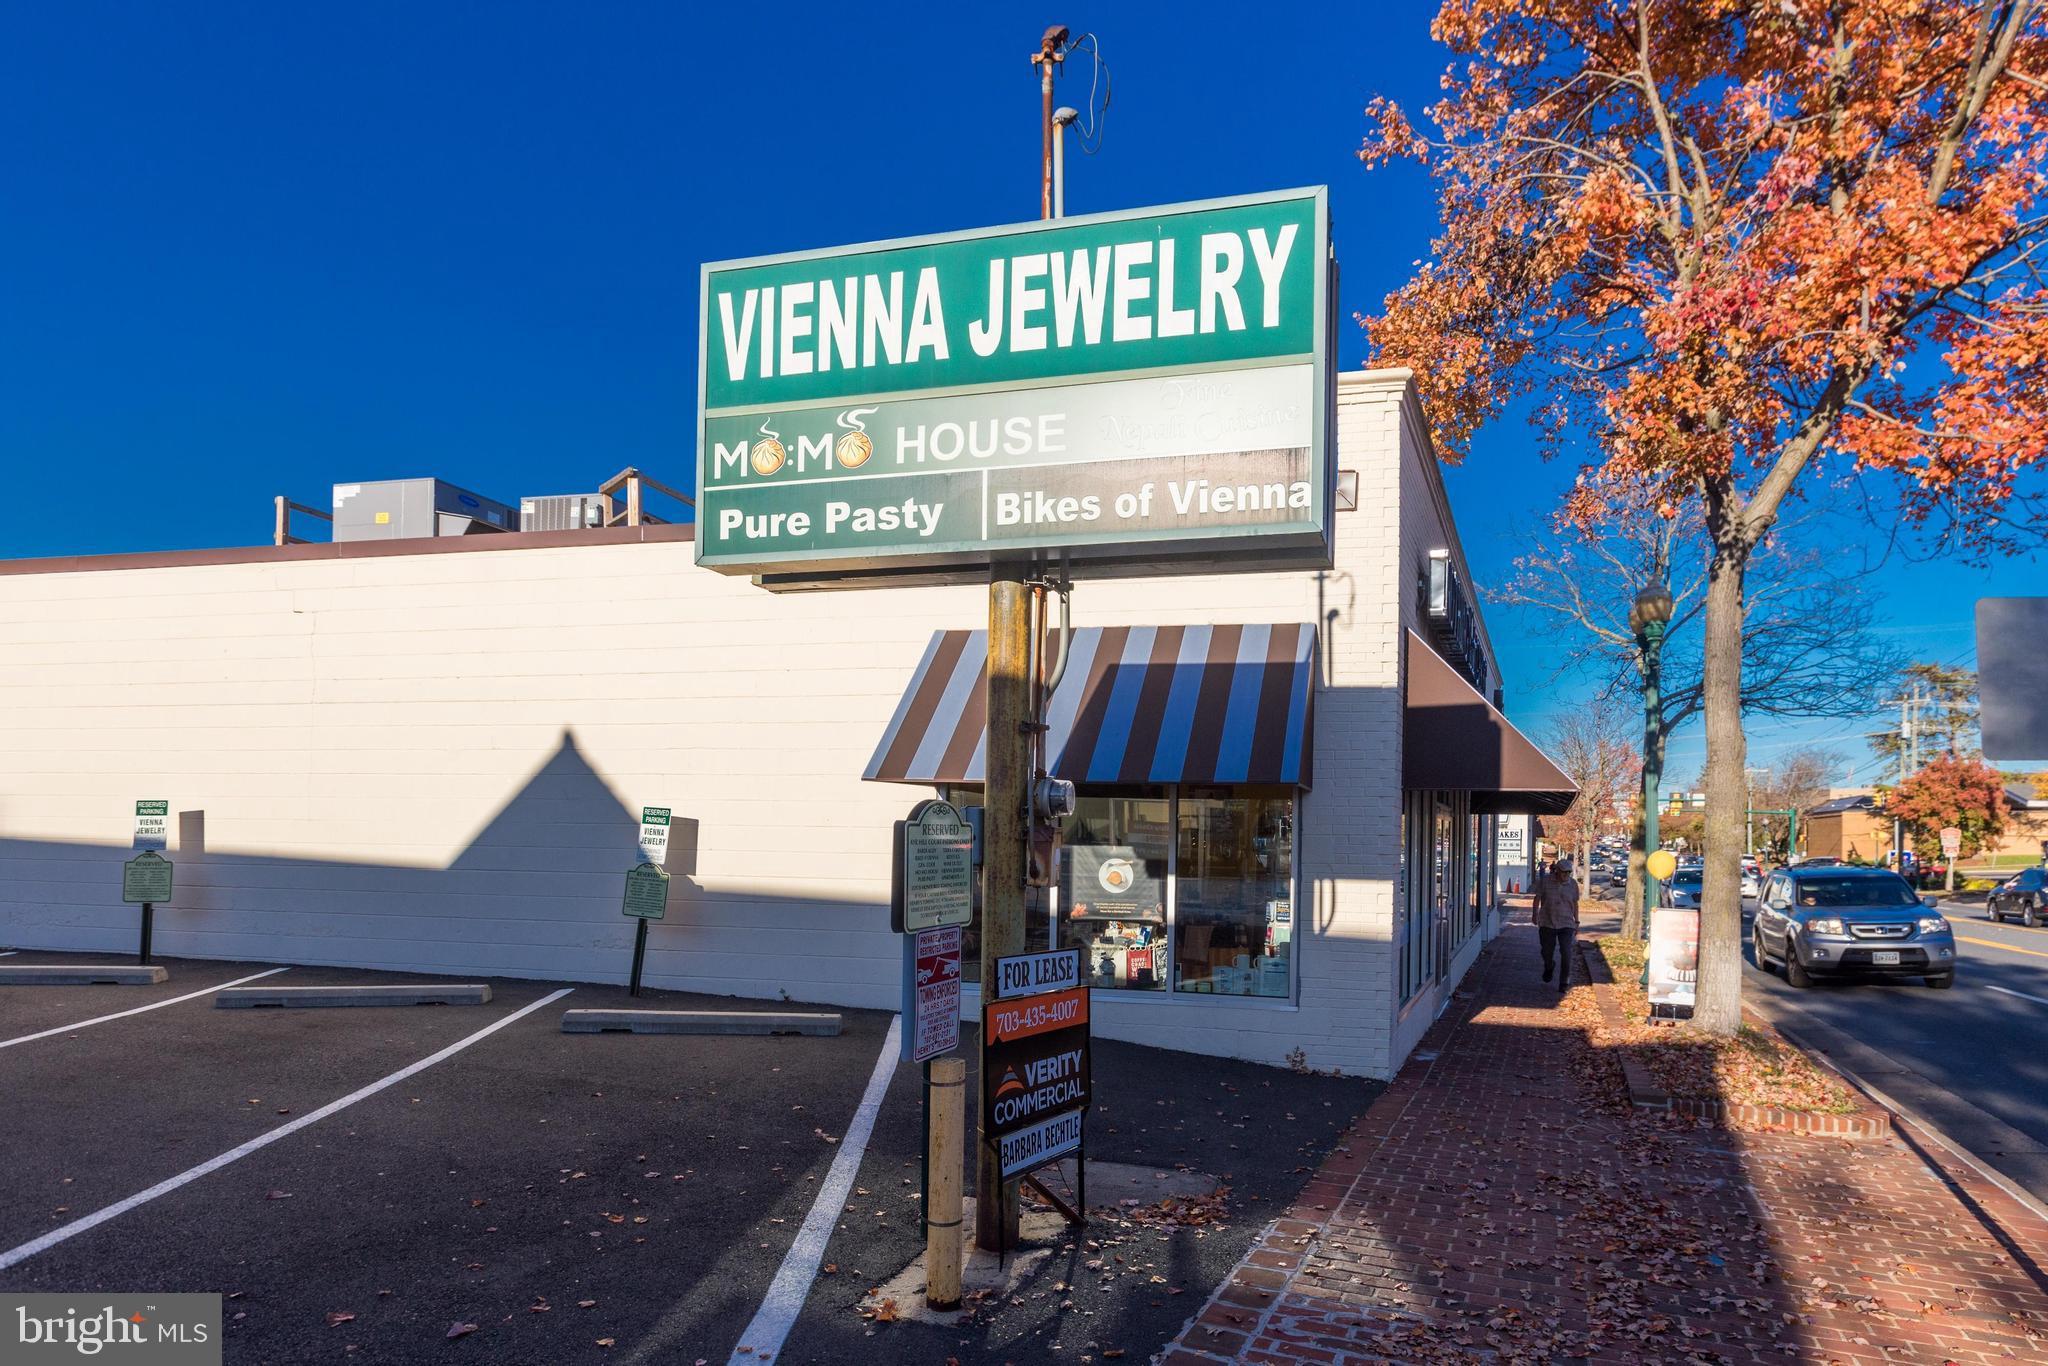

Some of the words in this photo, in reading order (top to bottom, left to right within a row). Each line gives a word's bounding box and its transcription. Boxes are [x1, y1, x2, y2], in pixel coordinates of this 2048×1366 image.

[718, 266, 950, 381] VIENNA
[968, 223, 1300, 357] JEWELRY
[897, 413, 1066, 465] HOUSE
[720, 507, 811, 540] Pure
[825, 497, 944, 537] Pasty
[996, 489, 1101, 526] Bikes
[1115, 481, 1154, 519] of
[1166, 479, 1313, 516] Vienna
[644, 808, 670, 817] RESERVED
[645, 816, 667, 824] PARKING
[922, 823, 960, 836] RESERVED
[136, 827, 166, 835] JEWELRY
[640, 837, 667, 846] JEWELRY
[644, 828, 665, 836] VIENNA
[1003, 961, 1030, 990] FOR
[1035, 955, 1074, 985] LEASE
[996, 999, 1079, 1034] 703-435-4007
[1025, 1049, 1083, 1087] VERITY
[994, 1077, 1084, 1125] COMMERCIAL
[1003, 1130, 1043, 1168] BARBARA
[1045, 1116, 1079, 1148] BECHTLE
